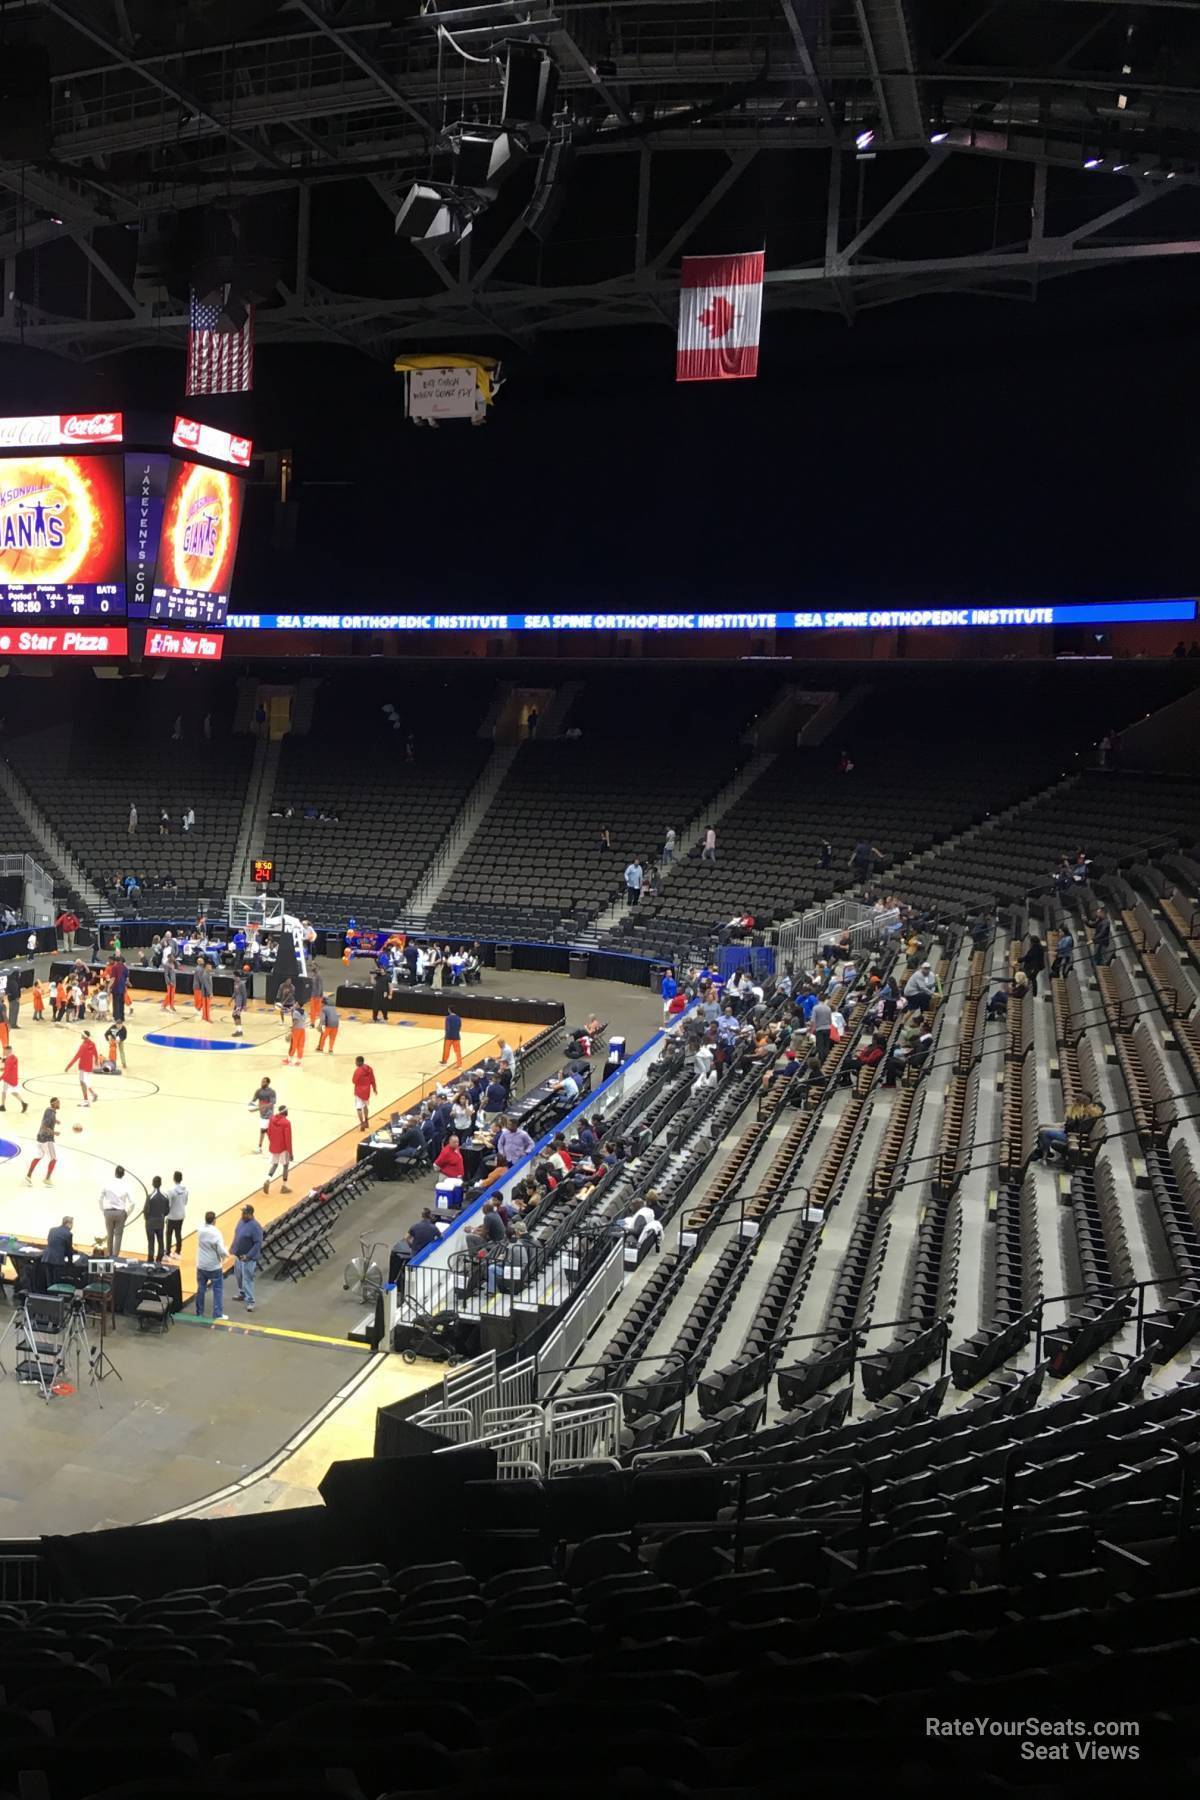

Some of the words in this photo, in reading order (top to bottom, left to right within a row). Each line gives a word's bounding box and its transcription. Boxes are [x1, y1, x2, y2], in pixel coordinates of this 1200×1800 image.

[96, 586, 117, 594] BATS
[101, 600, 109, 612] 0
[276, 615, 302, 628] SEA
[303, 615, 340, 628] SPINE
[341, 615, 431, 628] ORTHOPEDIC
[434, 615, 508, 628] INSTITUTE
[524, 616, 550, 628] SEA
[552, 616, 593, 628] SPINE
[594, 615, 695, 628] ORTHOPEDIC
[697, 614, 776, 628] INSTITUTE
[794, 613, 823, 627] SEA
[825, 612, 868, 627] SPINE
[869, 610, 969, 626] ORTHOPEDIC
[971, 608, 1053, 625] INSTITUTE
[18, 633, 58, 650] Star
[62, 633, 108, 651] Pizza
[161, 634, 180, 653] Five
[181, 637, 198, 654] Star
[198, 638, 217, 655] Pizza
[255, 869, 270, 881] 24
